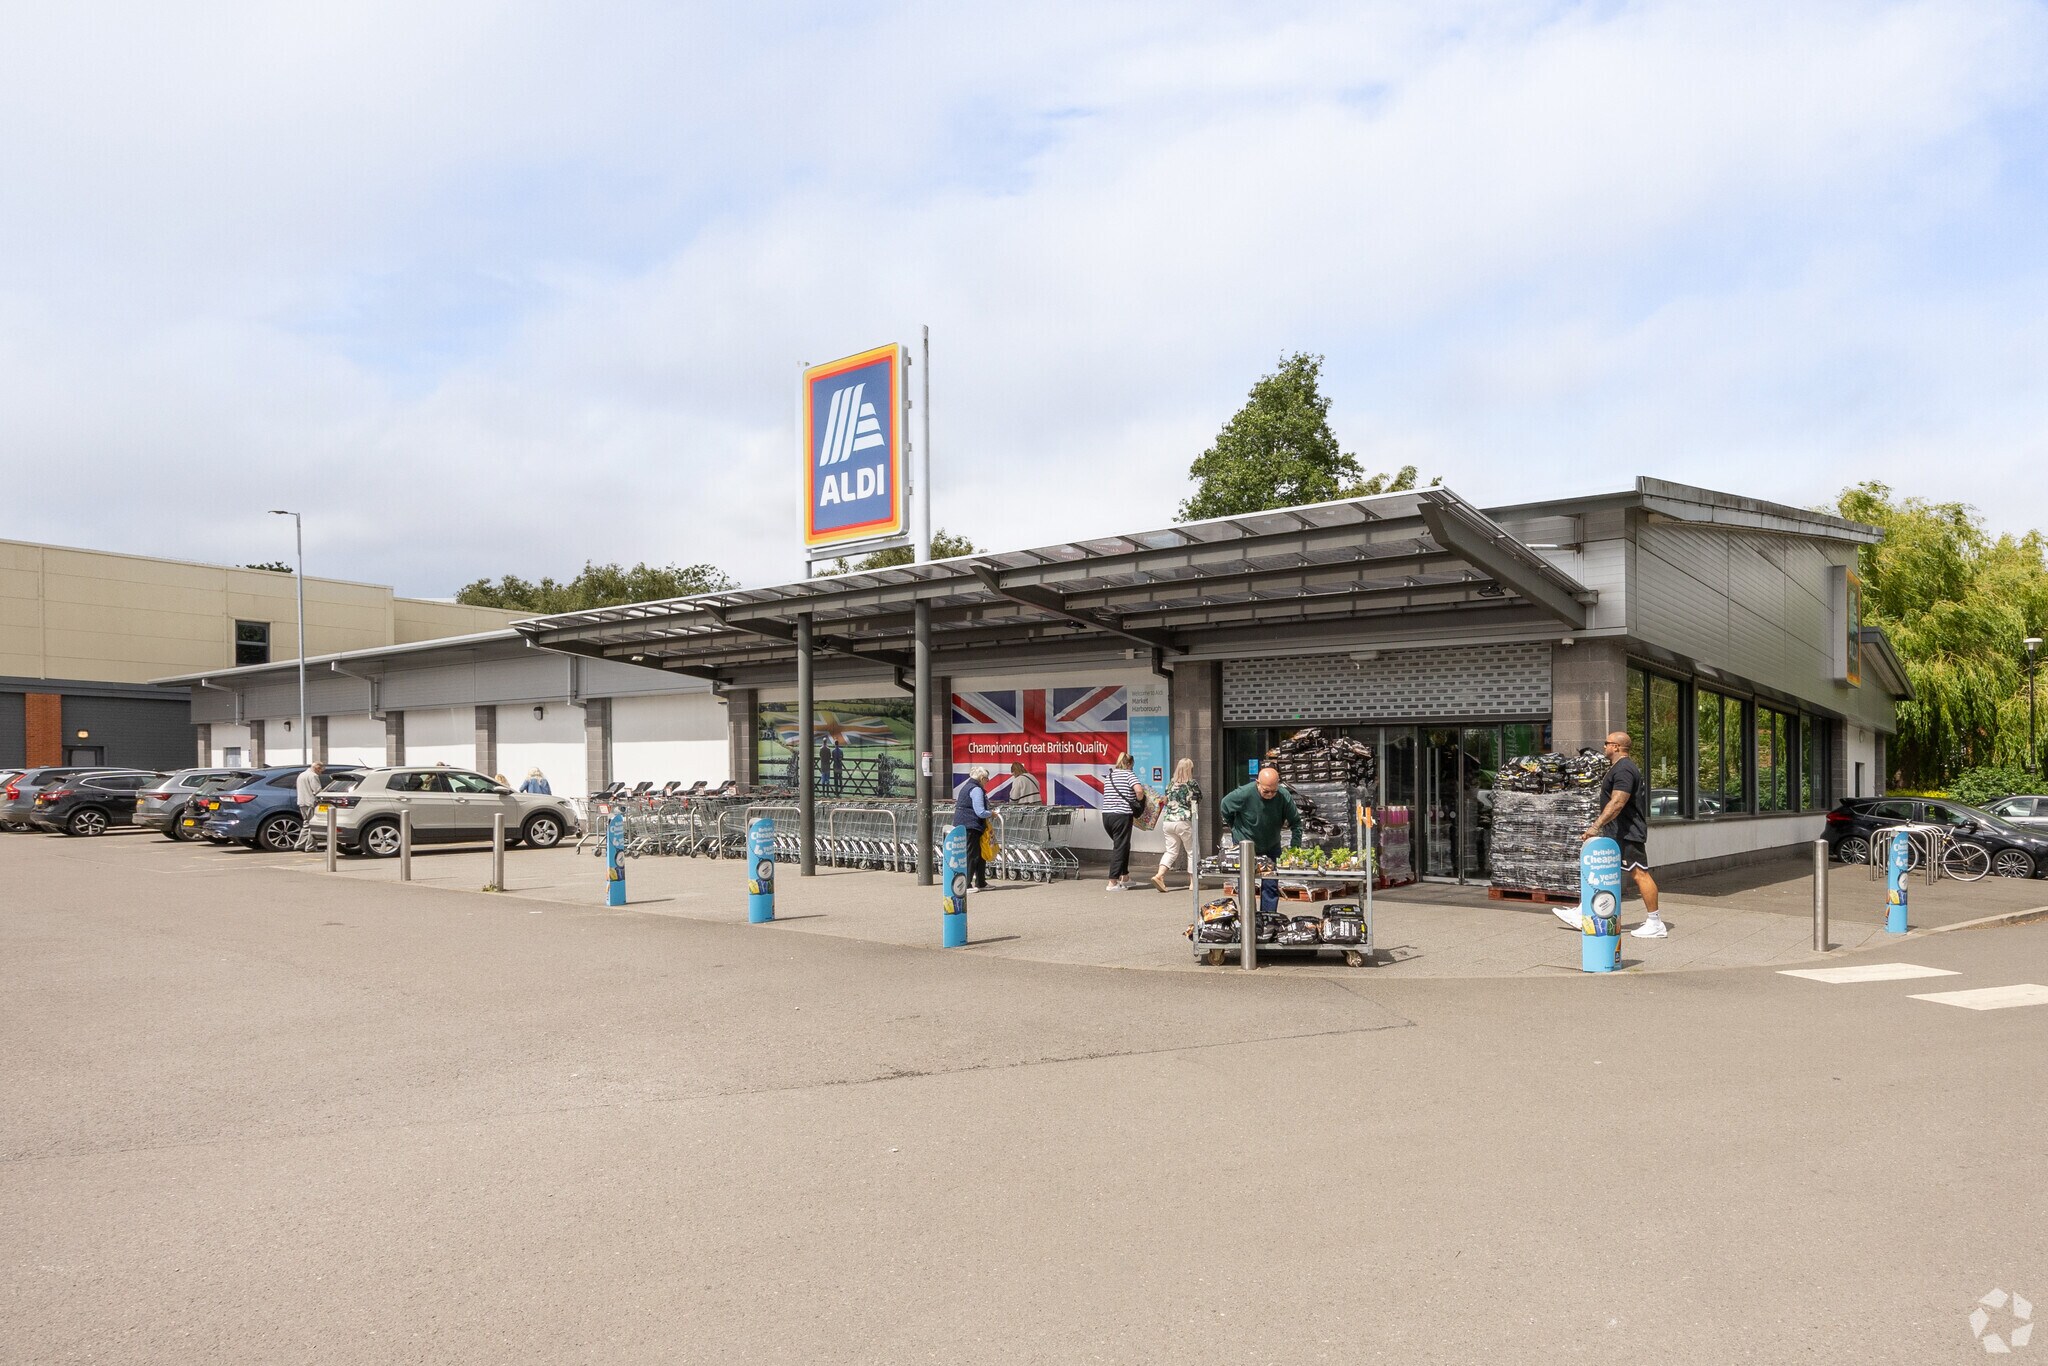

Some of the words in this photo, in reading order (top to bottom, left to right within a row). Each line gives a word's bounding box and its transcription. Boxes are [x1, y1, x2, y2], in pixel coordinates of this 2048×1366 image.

[819, 463, 885, 507] ALDI
[1132, 705, 1162, 713] Harborough
[968, 741, 1022, 756] Championing
[1023, 742, 1046, 753] Great
[1047, 741, 1074, 753] British
[1076, 741, 1108, 757] Quality
[1588, 872, 1599, 885] 4
